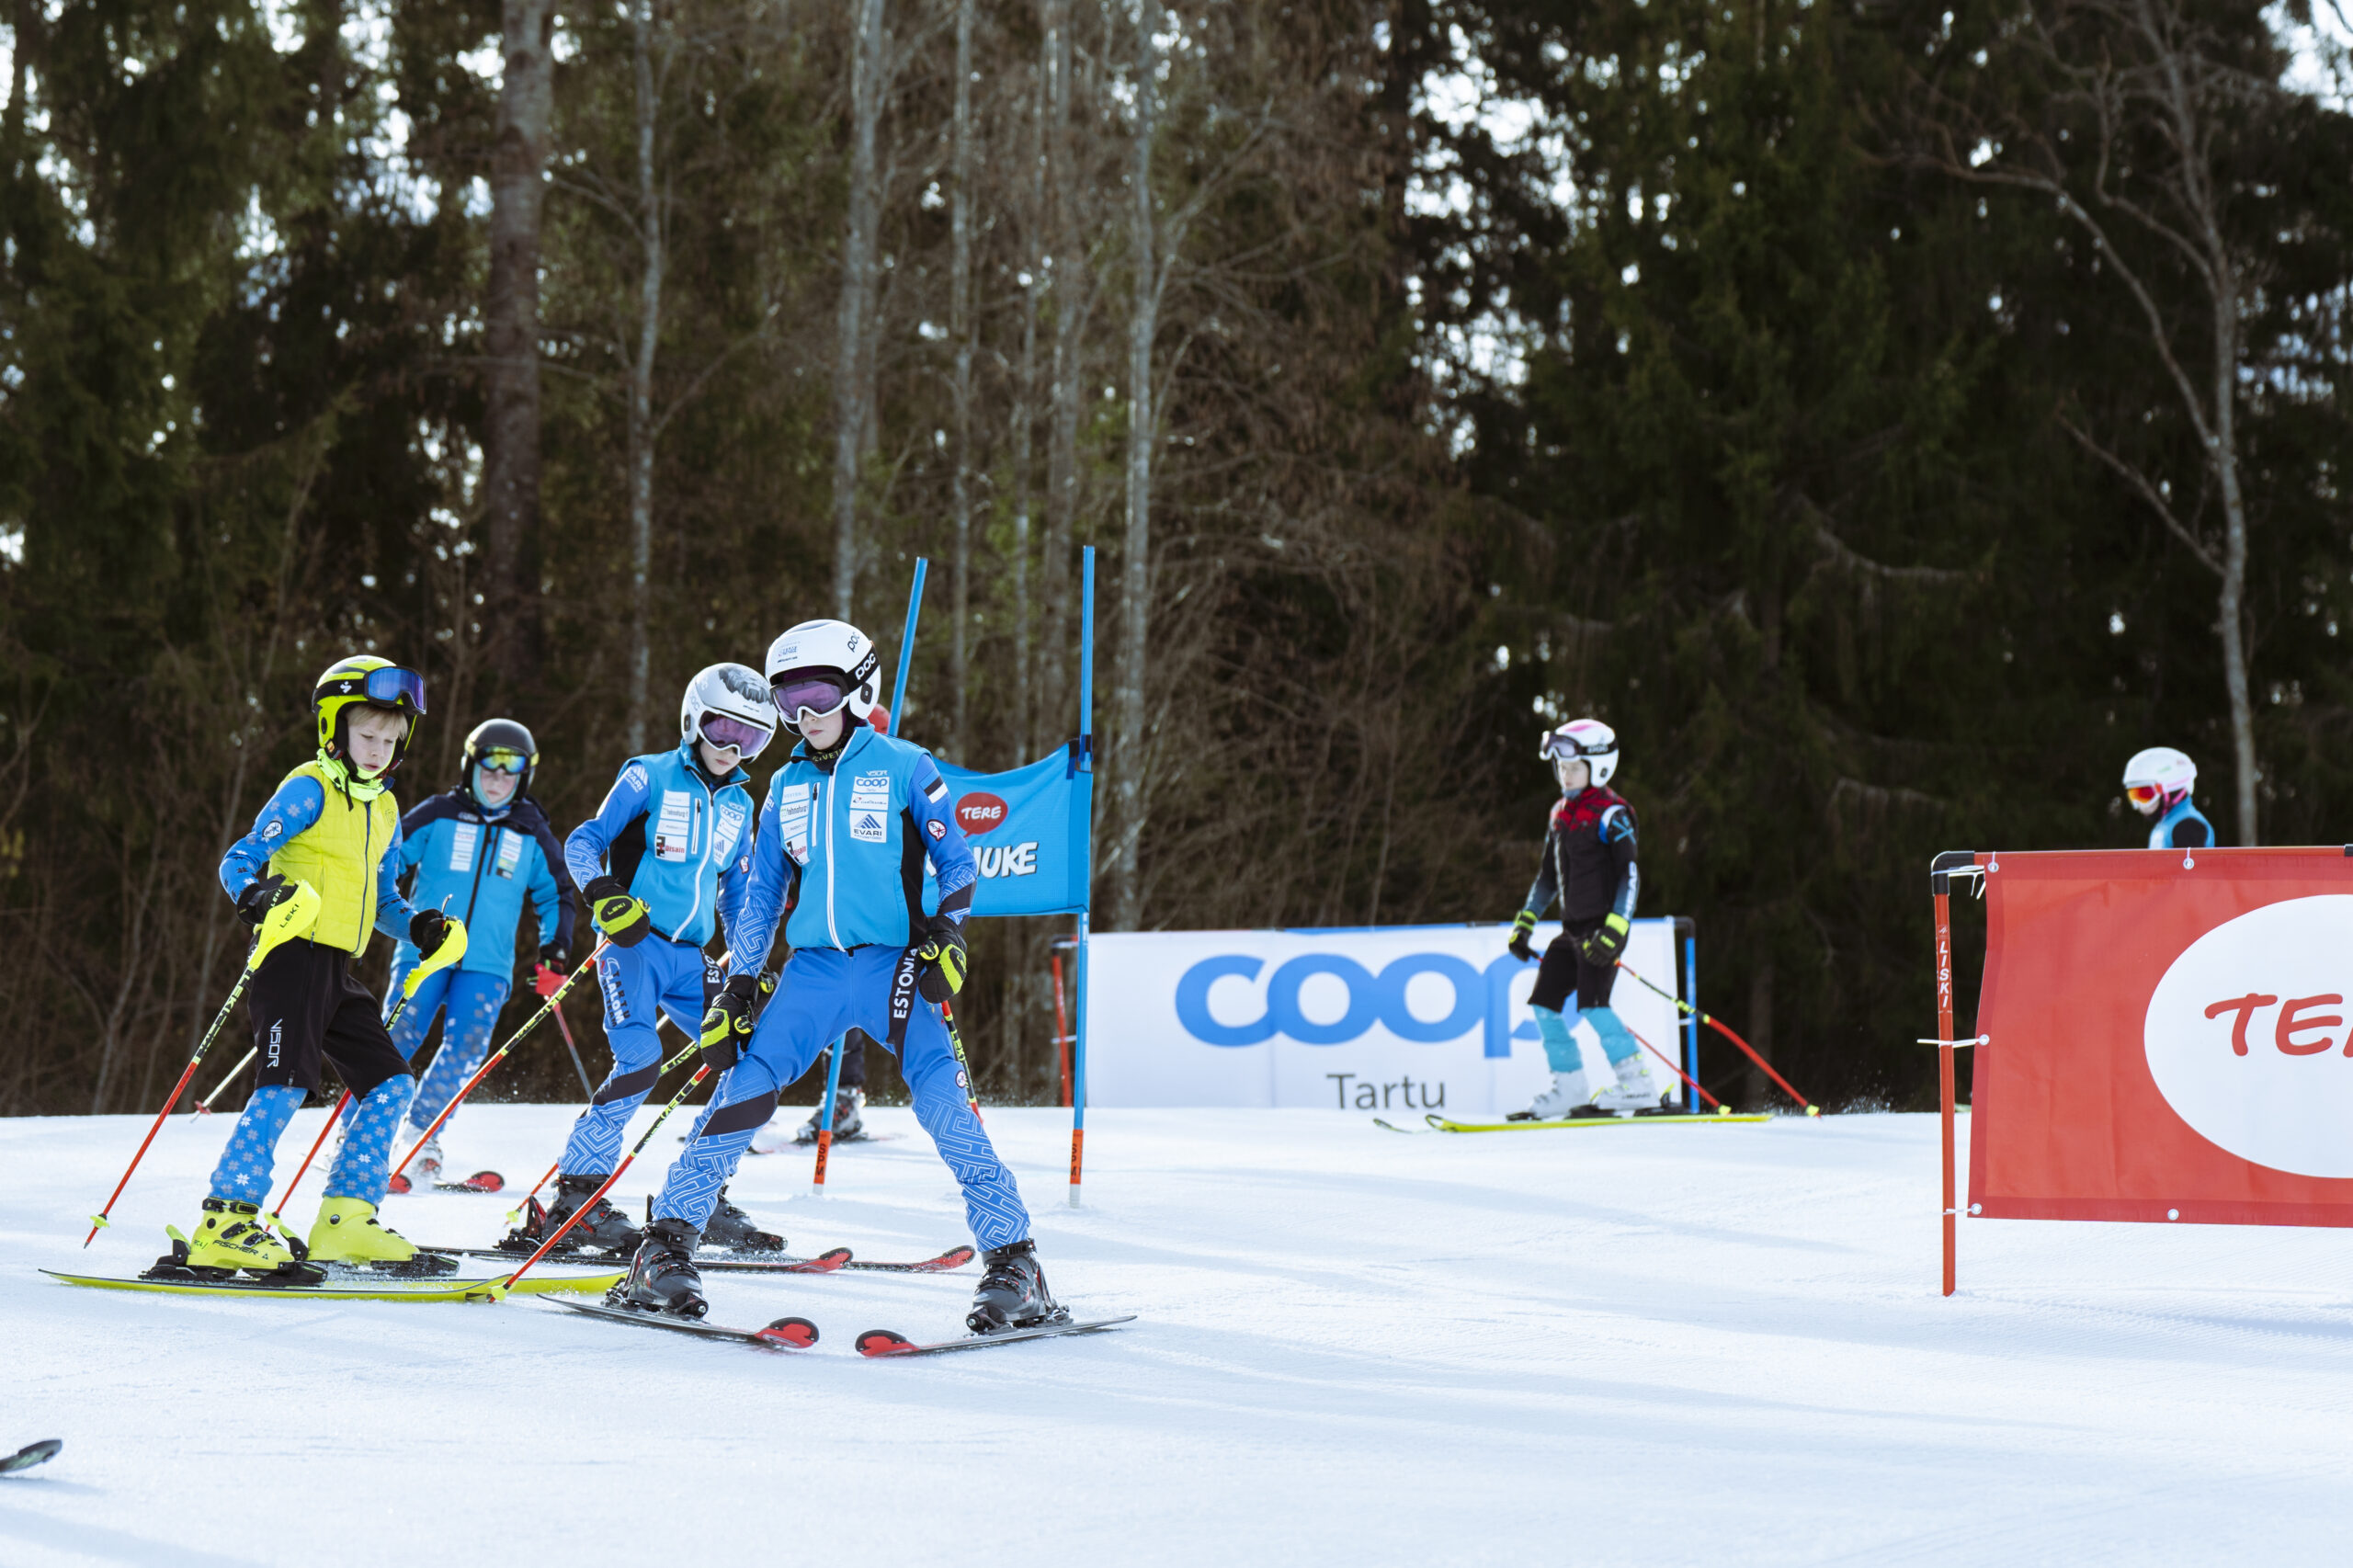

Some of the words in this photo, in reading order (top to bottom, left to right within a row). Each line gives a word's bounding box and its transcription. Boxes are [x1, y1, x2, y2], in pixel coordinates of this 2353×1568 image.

[961, 806, 1002, 821] TERE
[279, 903, 299, 928] LEKI
[608, 903, 626, 915] LEKI
[615, 971, 631, 1020] TARTU
[893, 948, 918, 1019] ESTONIA
[1939, 941, 1949, 1008] LISKI
[267, 1018, 282, 1068] VISOR
[2204, 993, 2353, 1058] TE
[1326, 1073, 1446, 1110] Tartu
[212, 1240, 258, 1256] FISCHER
